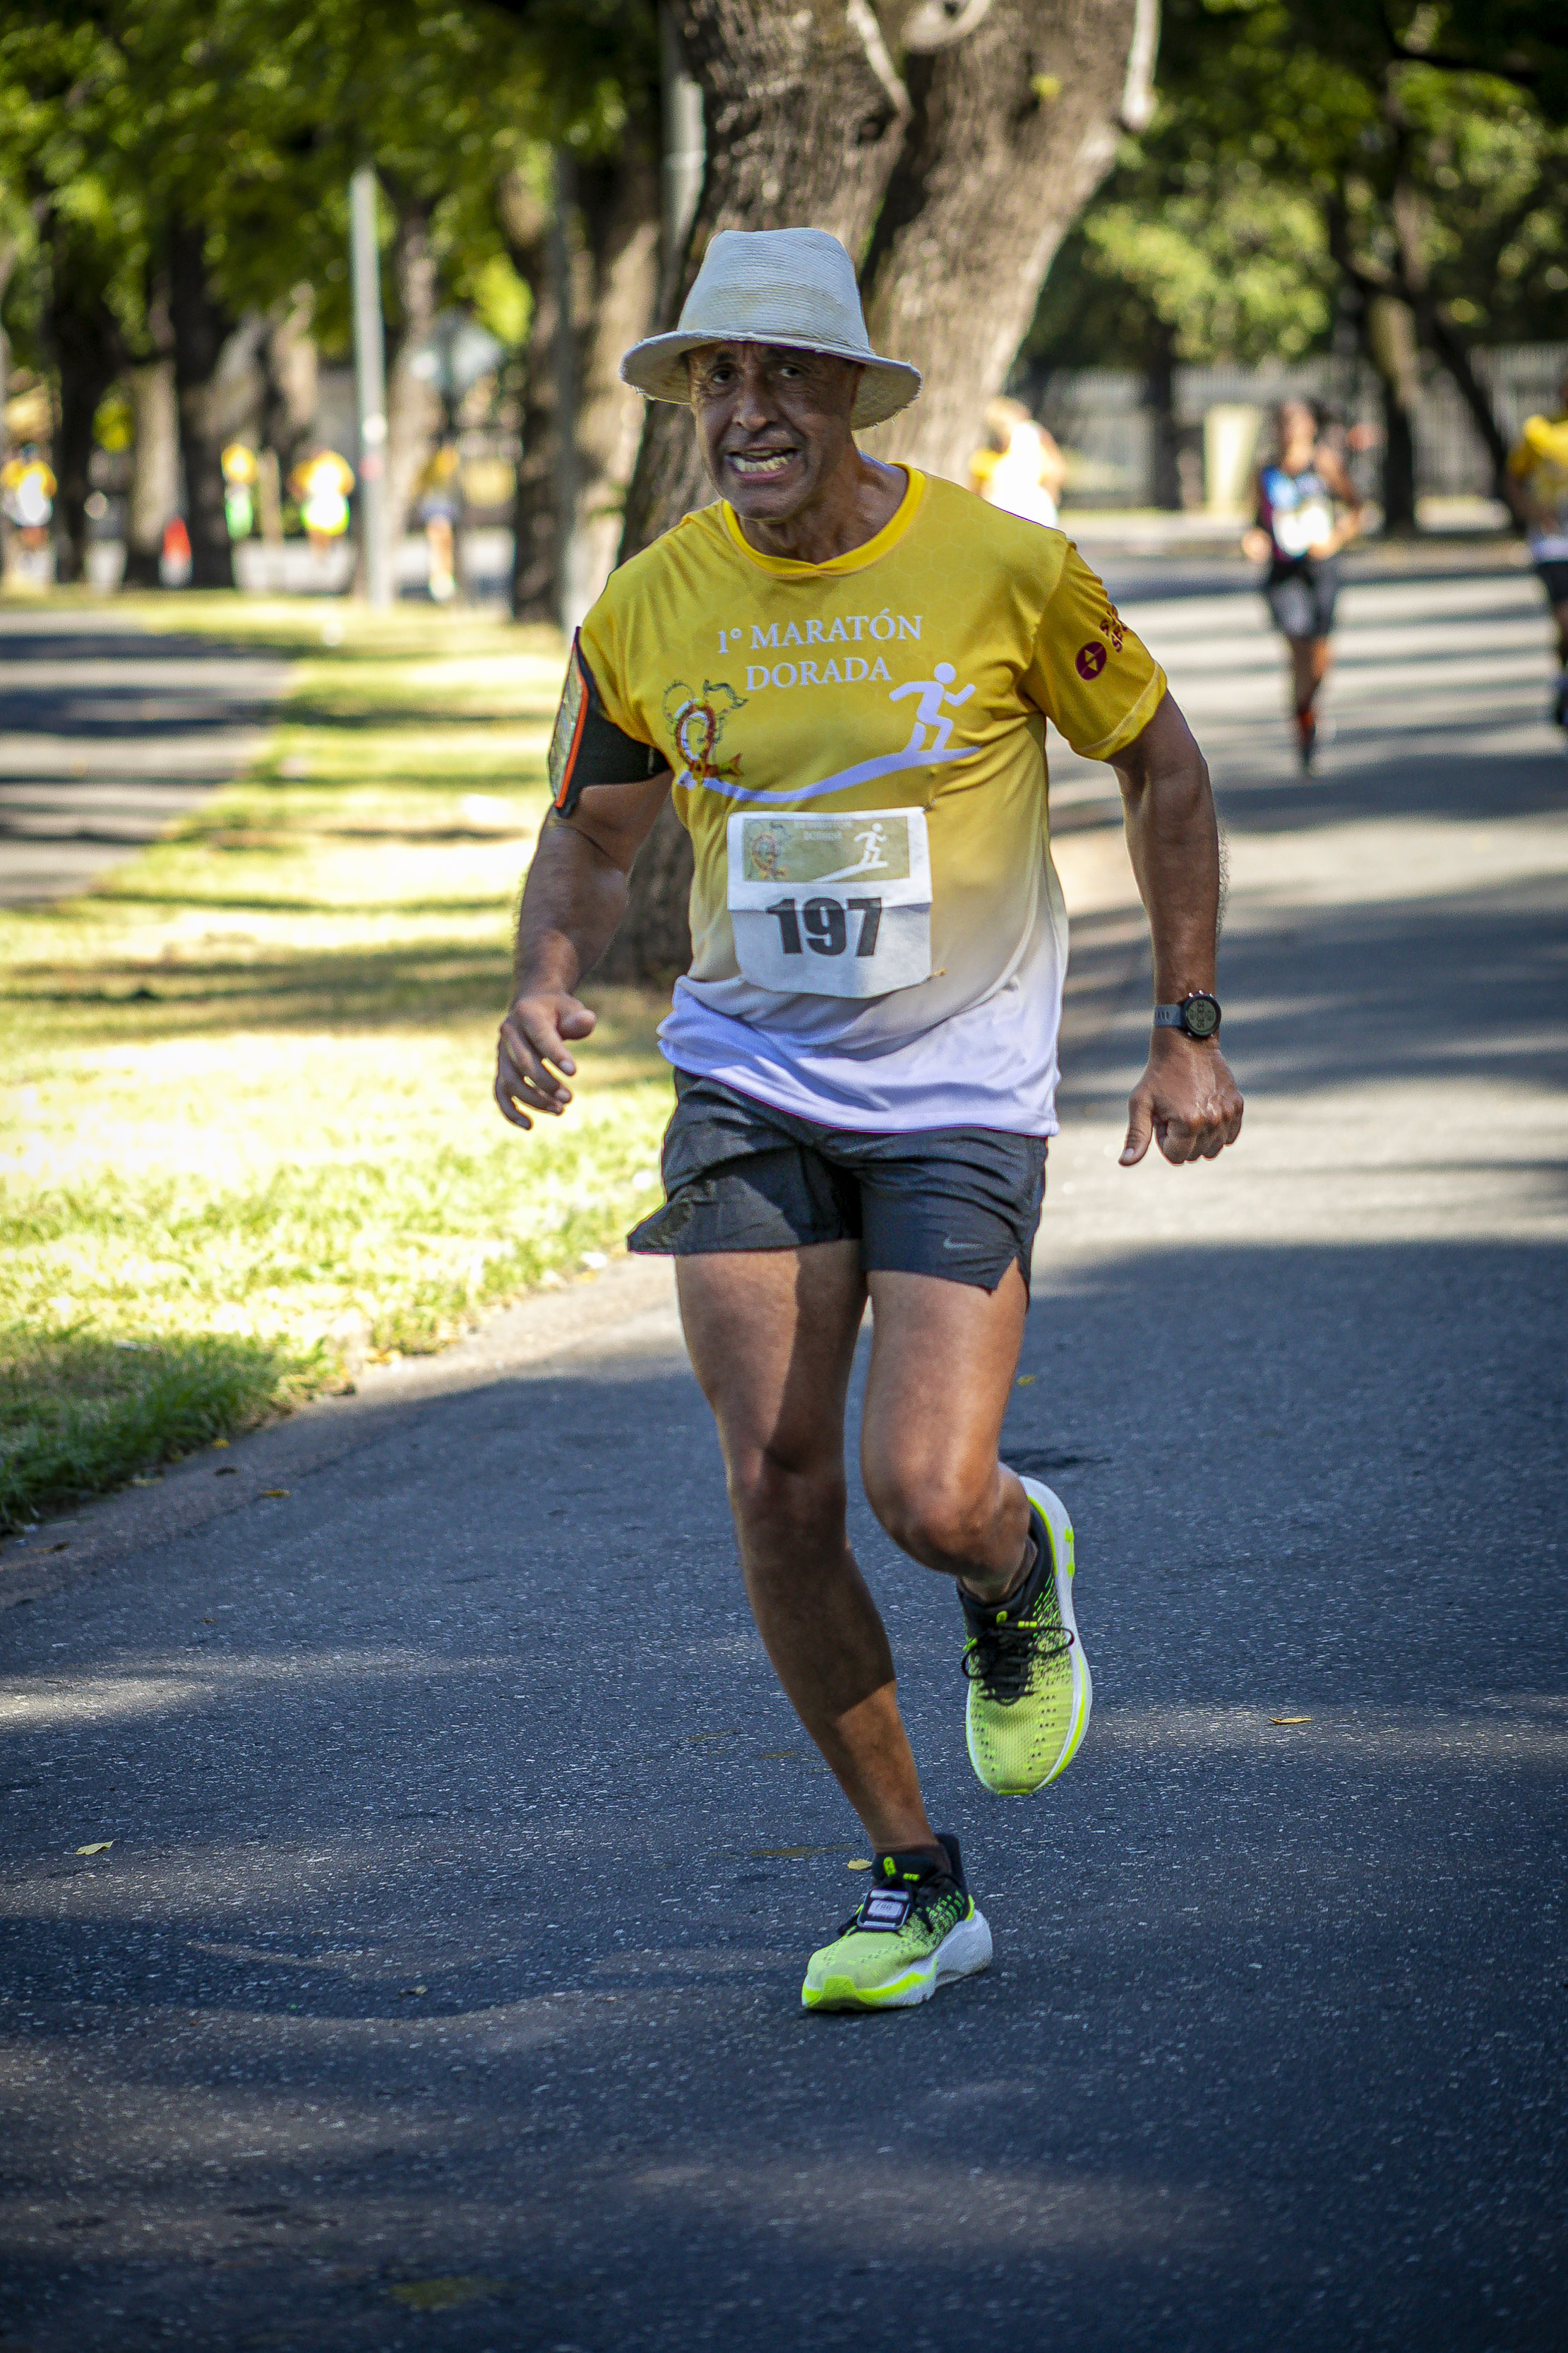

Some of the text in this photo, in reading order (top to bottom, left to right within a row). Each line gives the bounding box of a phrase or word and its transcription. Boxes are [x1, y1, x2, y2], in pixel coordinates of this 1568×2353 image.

[750, 607, 923, 650] MARATÓN
[745, 656, 892, 691] DORADA
[766, 897, 882, 957] 197
